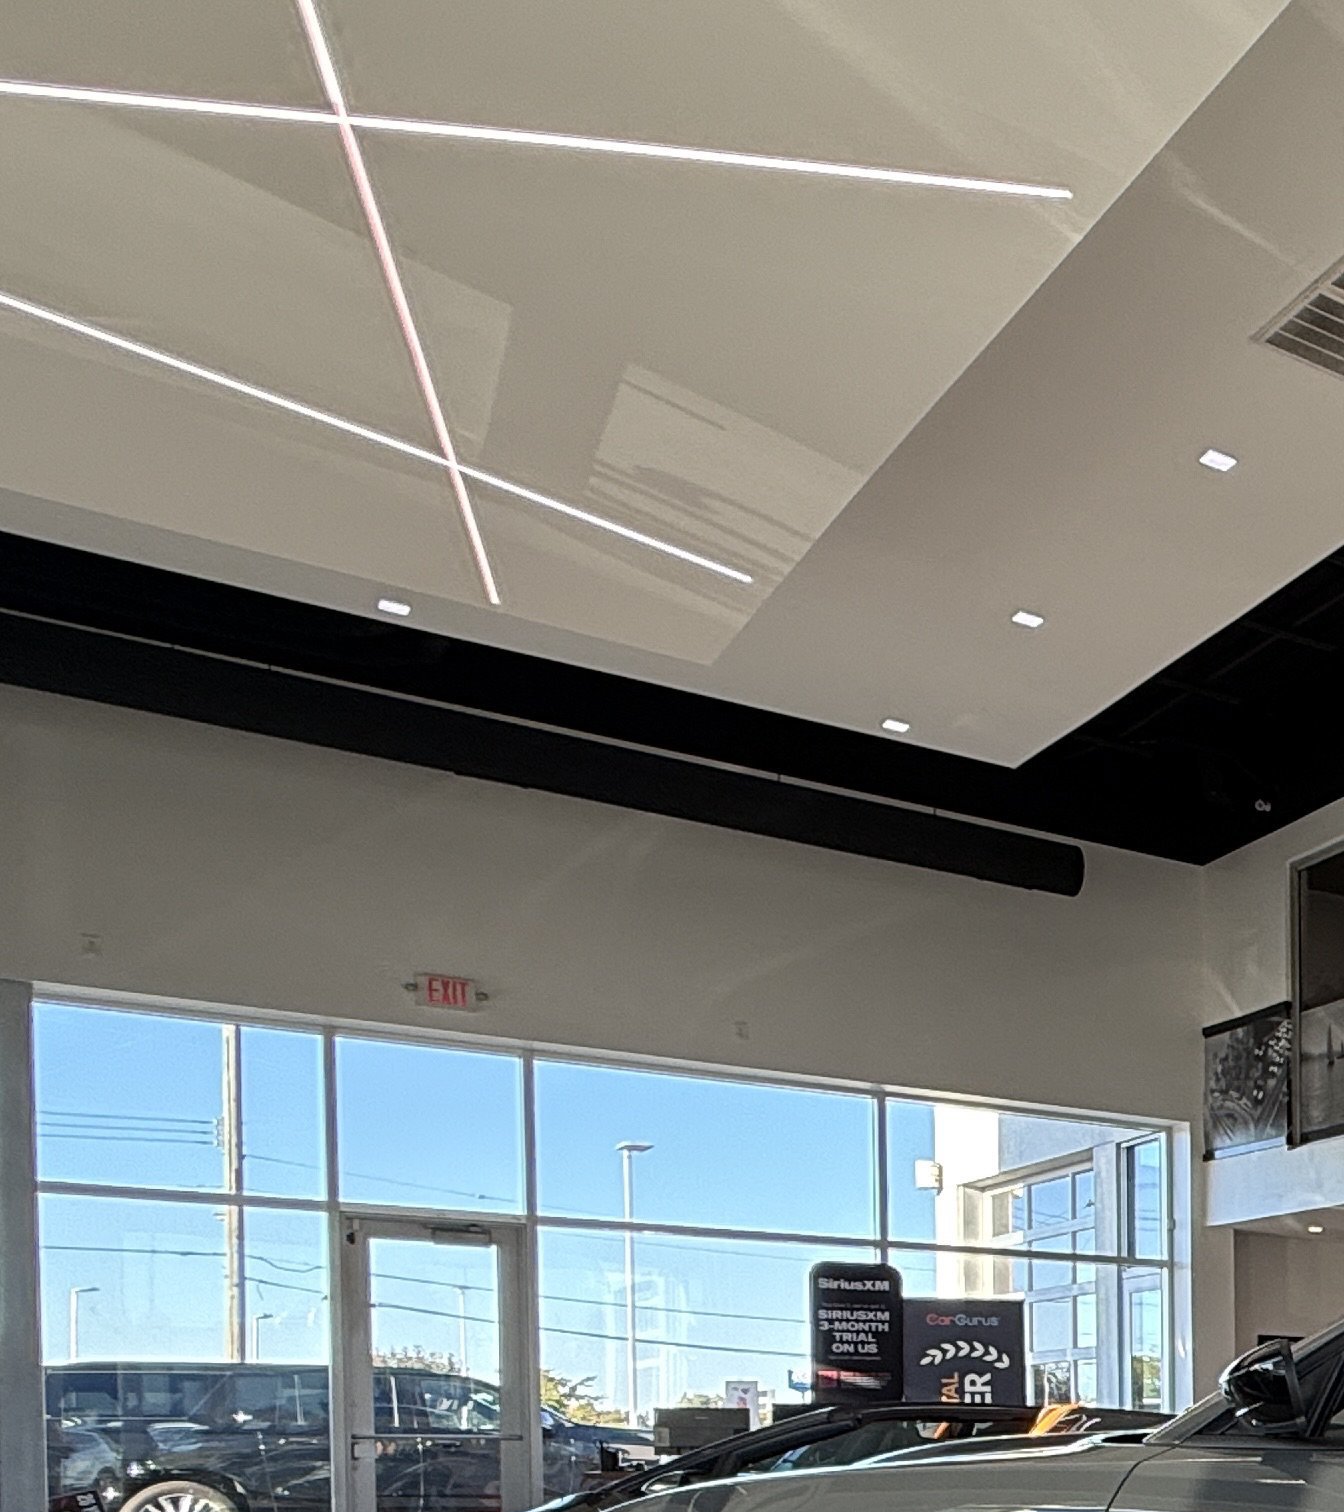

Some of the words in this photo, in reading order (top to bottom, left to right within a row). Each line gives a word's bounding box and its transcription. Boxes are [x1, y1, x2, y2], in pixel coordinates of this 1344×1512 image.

[428, 976, 469, 1008] EXIT
[818, 1277, 890, 1292] SiriusXM
[926, 1313, 999, 1326] CarGurus
[818, 1321, 889, 1332] 3-MONTH
[833, 1332, 876, 1342] TRIAL
[831, 1342, 855, 1354] ON
[857, 1343, 879, 1354] US
